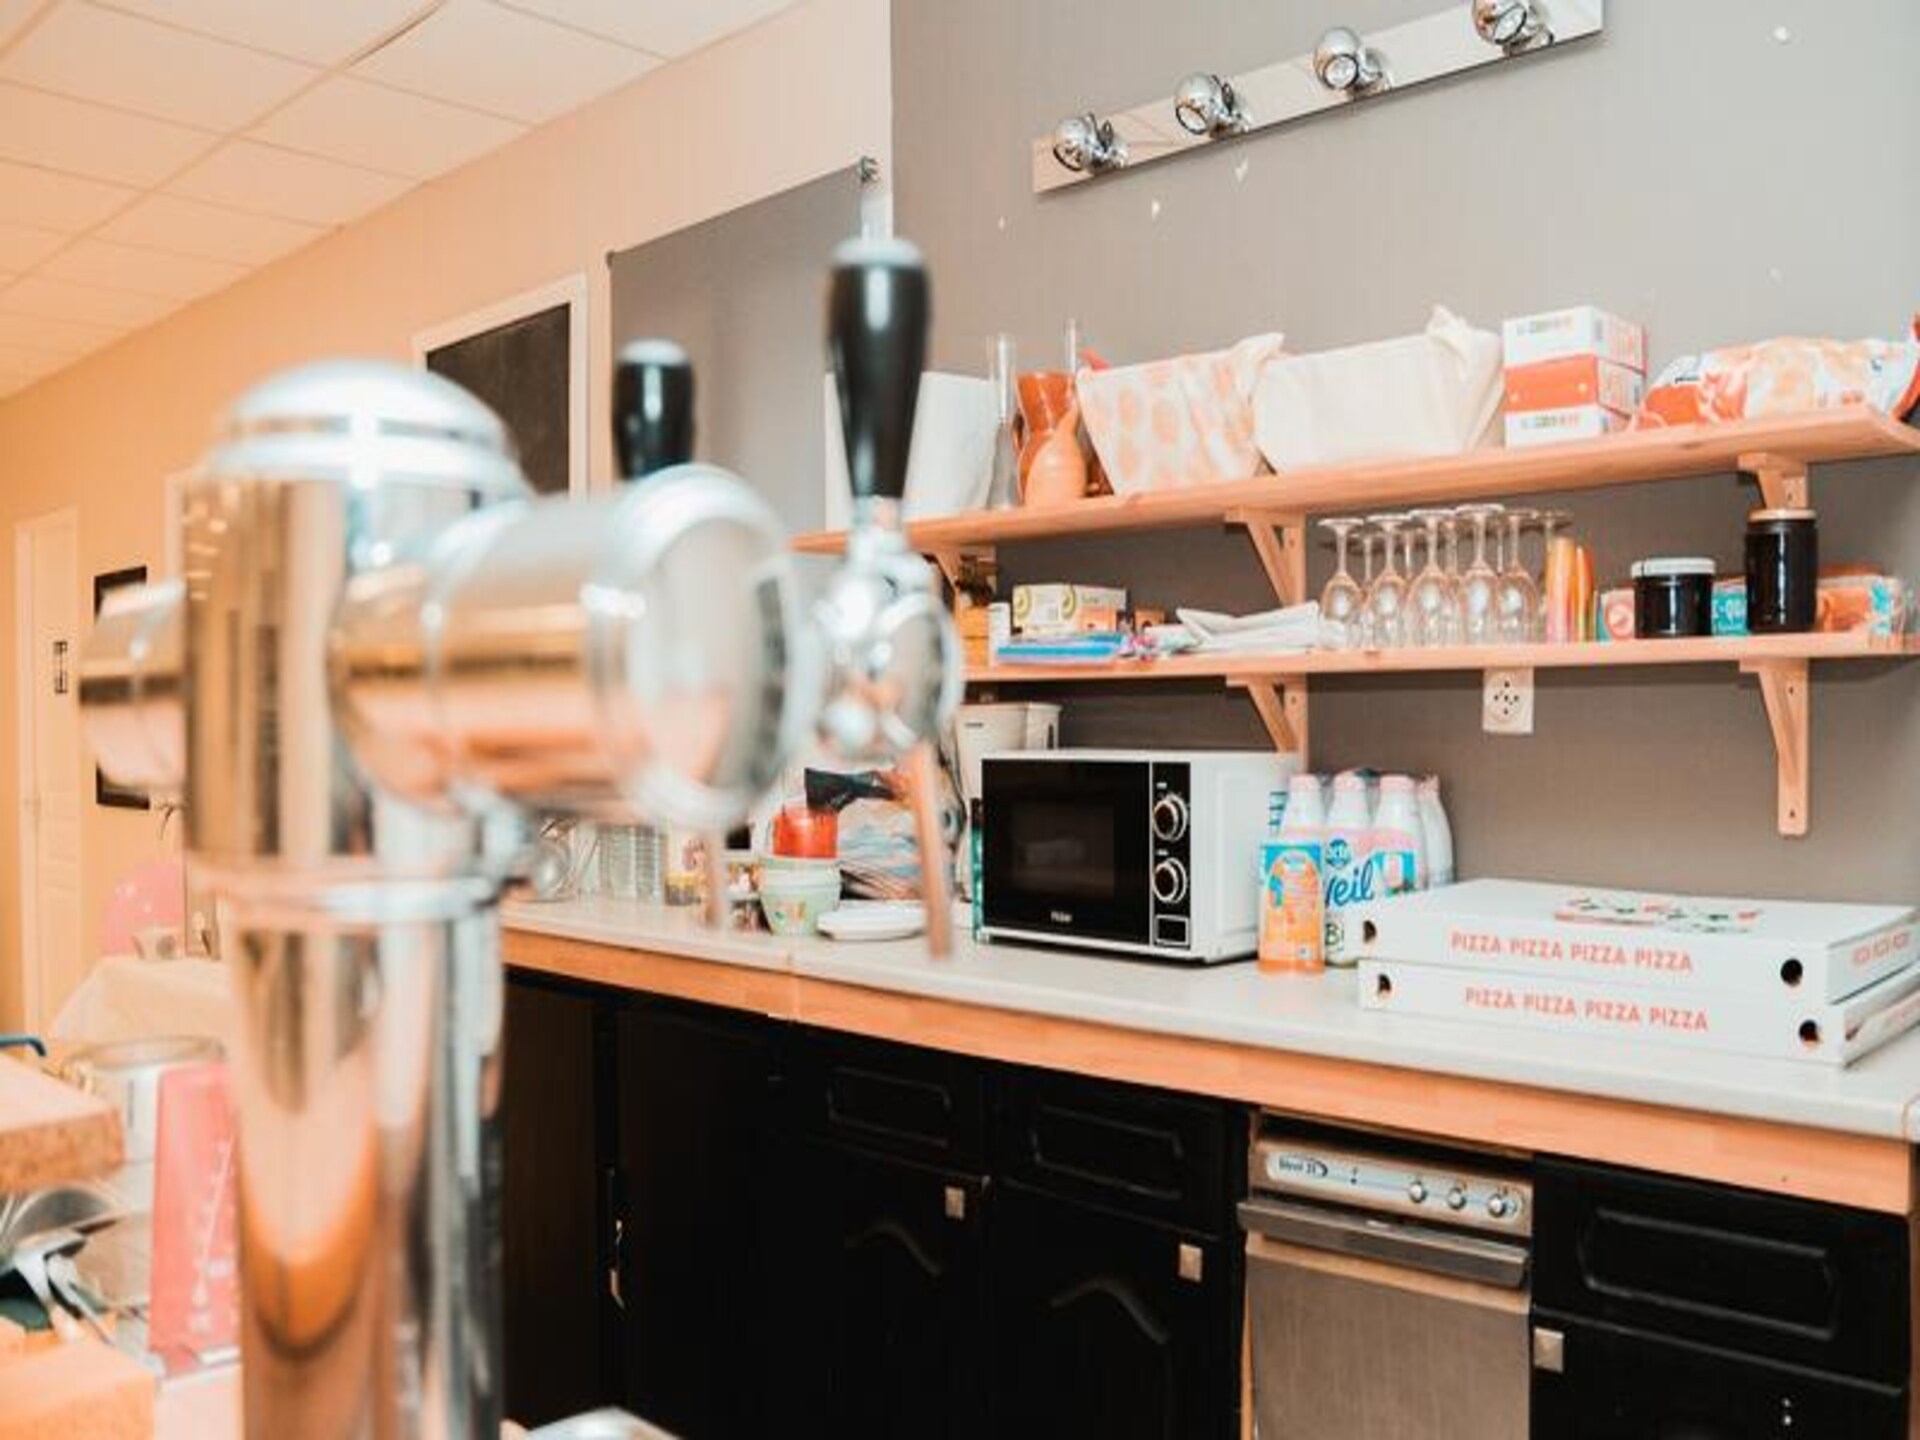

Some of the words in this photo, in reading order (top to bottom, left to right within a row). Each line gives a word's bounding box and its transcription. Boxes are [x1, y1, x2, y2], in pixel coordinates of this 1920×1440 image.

[1451, 931, 1501, 952] PIZZA
[1509, 937, 1563, 960] PIZZA
[1571, 942, 1627, 965] PIZZA
[1635, 948, 1692, 972] PIZZA
[1465, 987, 1516, 1009] PIZZA
[1523, 993, 1577, 1017] PIZZA
[1585, 999, 1641, 1023] PIZZA
[1650, 1006, 1708, 1031] PIZZA
